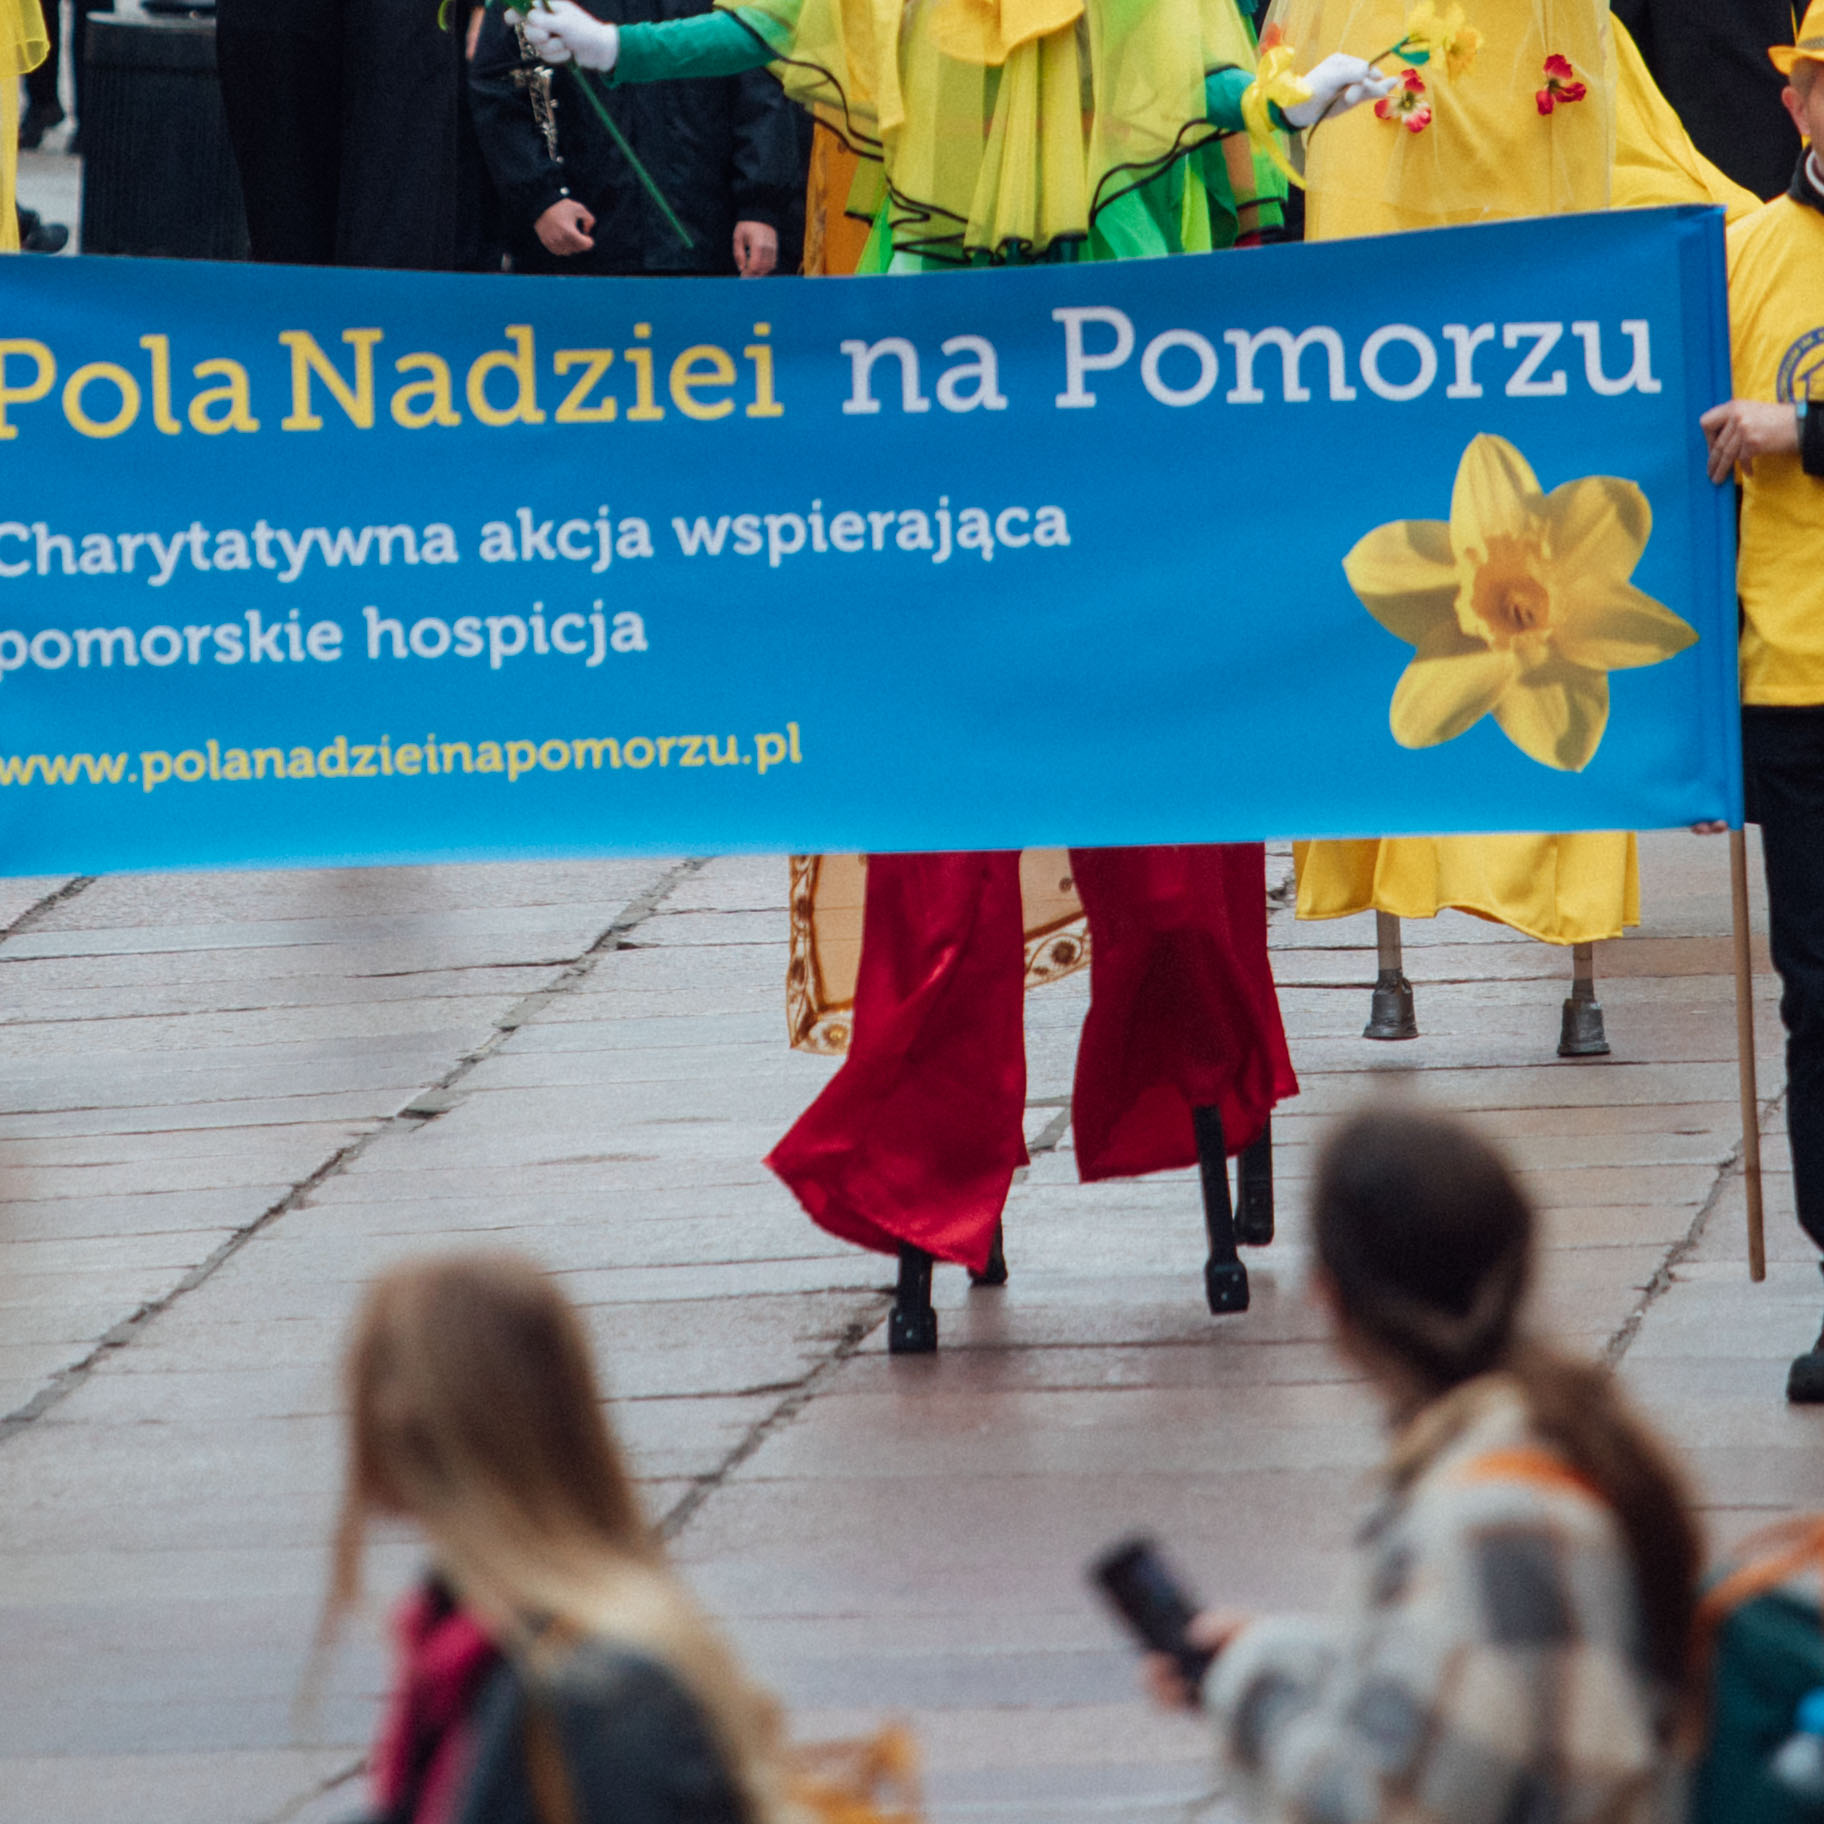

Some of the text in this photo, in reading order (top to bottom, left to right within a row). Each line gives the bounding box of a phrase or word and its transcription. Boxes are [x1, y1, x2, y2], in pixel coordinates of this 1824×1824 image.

[279, 324, 784, 431] Nadziei
[841, 336, 1007, 414] na
[1053, 307, 1661, 408] Pomorzu
[480, 507, 653, 572] akcja
[672, 497, 1070, 565] wspierająca
[364, 601, 647, 669] hospicja
